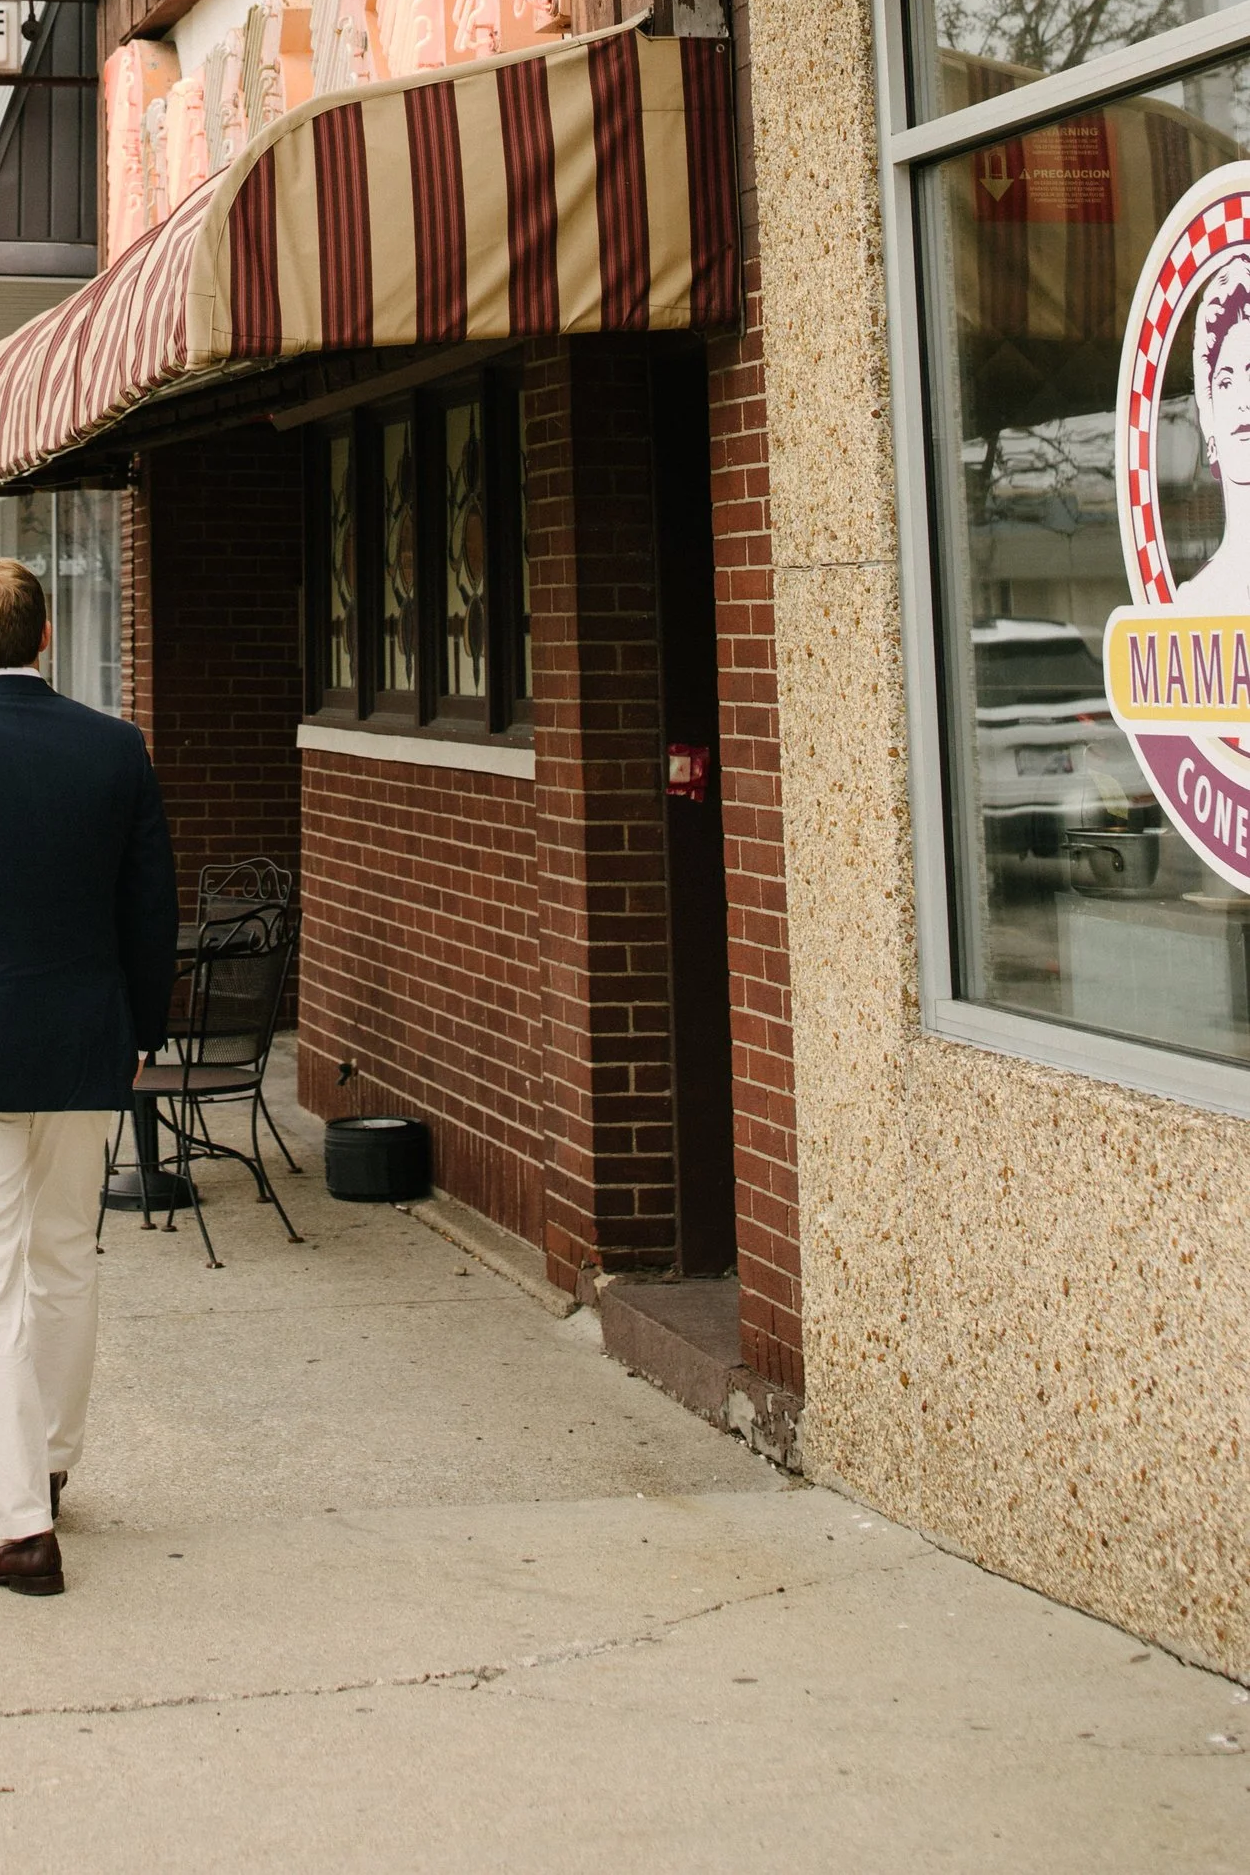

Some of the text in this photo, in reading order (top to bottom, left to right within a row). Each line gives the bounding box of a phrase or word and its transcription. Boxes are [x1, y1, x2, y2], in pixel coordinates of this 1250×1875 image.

[1033, 169, 1110, 179] PRECAUCION
[1127, 629, 1250, 709] MAMA
[1176, 757, 1249, 859] CONE
